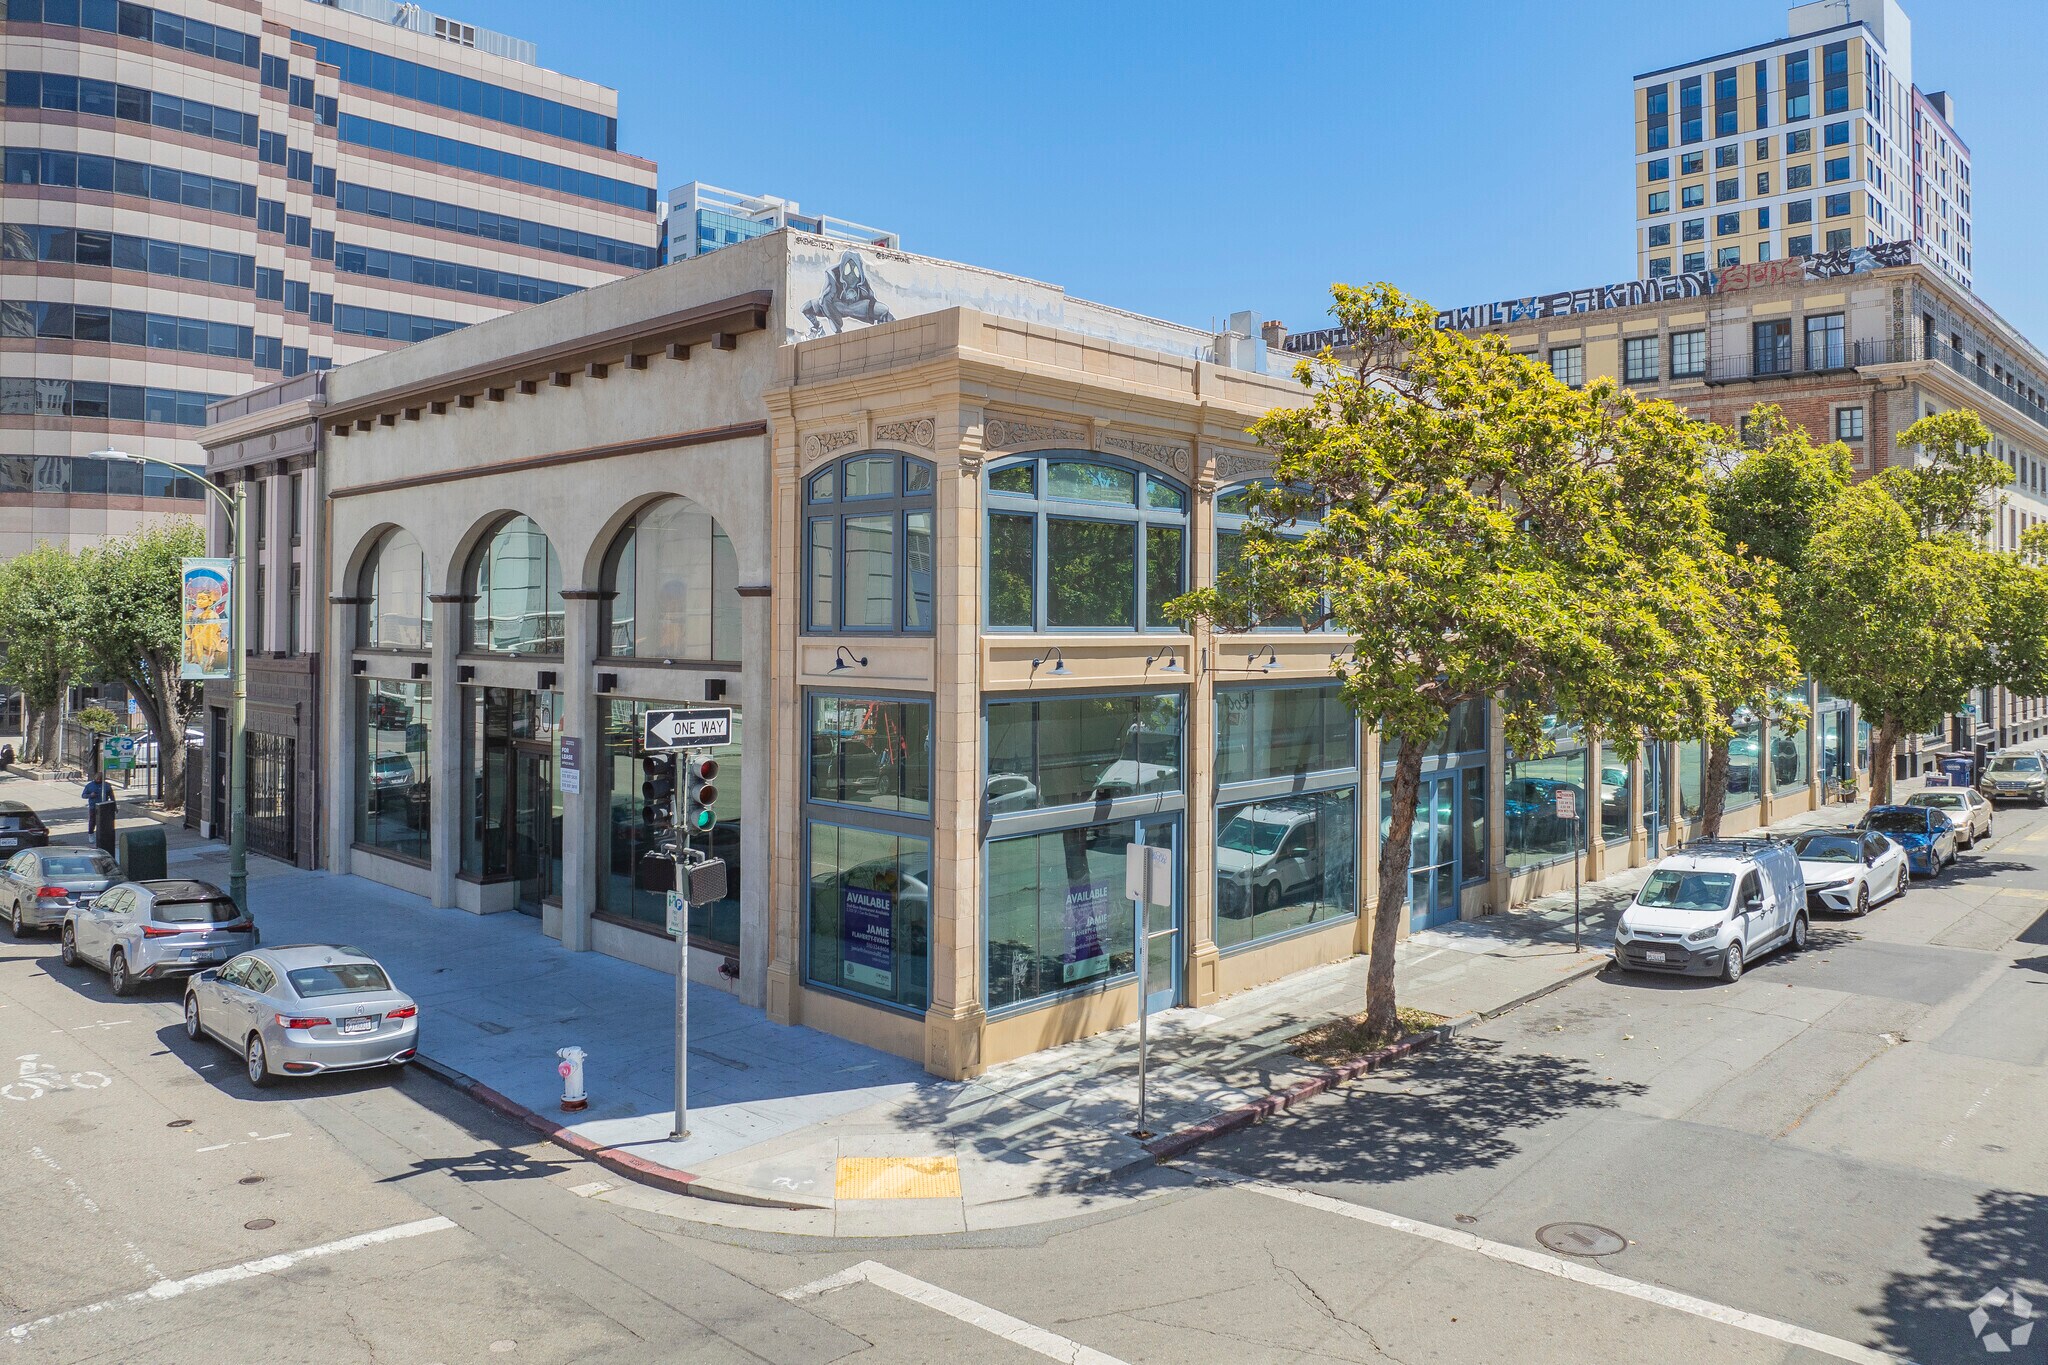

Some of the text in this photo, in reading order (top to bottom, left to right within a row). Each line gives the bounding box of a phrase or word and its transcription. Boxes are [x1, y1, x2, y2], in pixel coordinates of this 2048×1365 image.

[674, 720, 724, 735] ONE WAY
[846, 892, 890, 910] AVAILABLE
[1065, 886, 1108, 905] AVAILABLE
[1086, 913, 1108, 927] JAMIE
[866, 924, 890, 938] JAMIE
